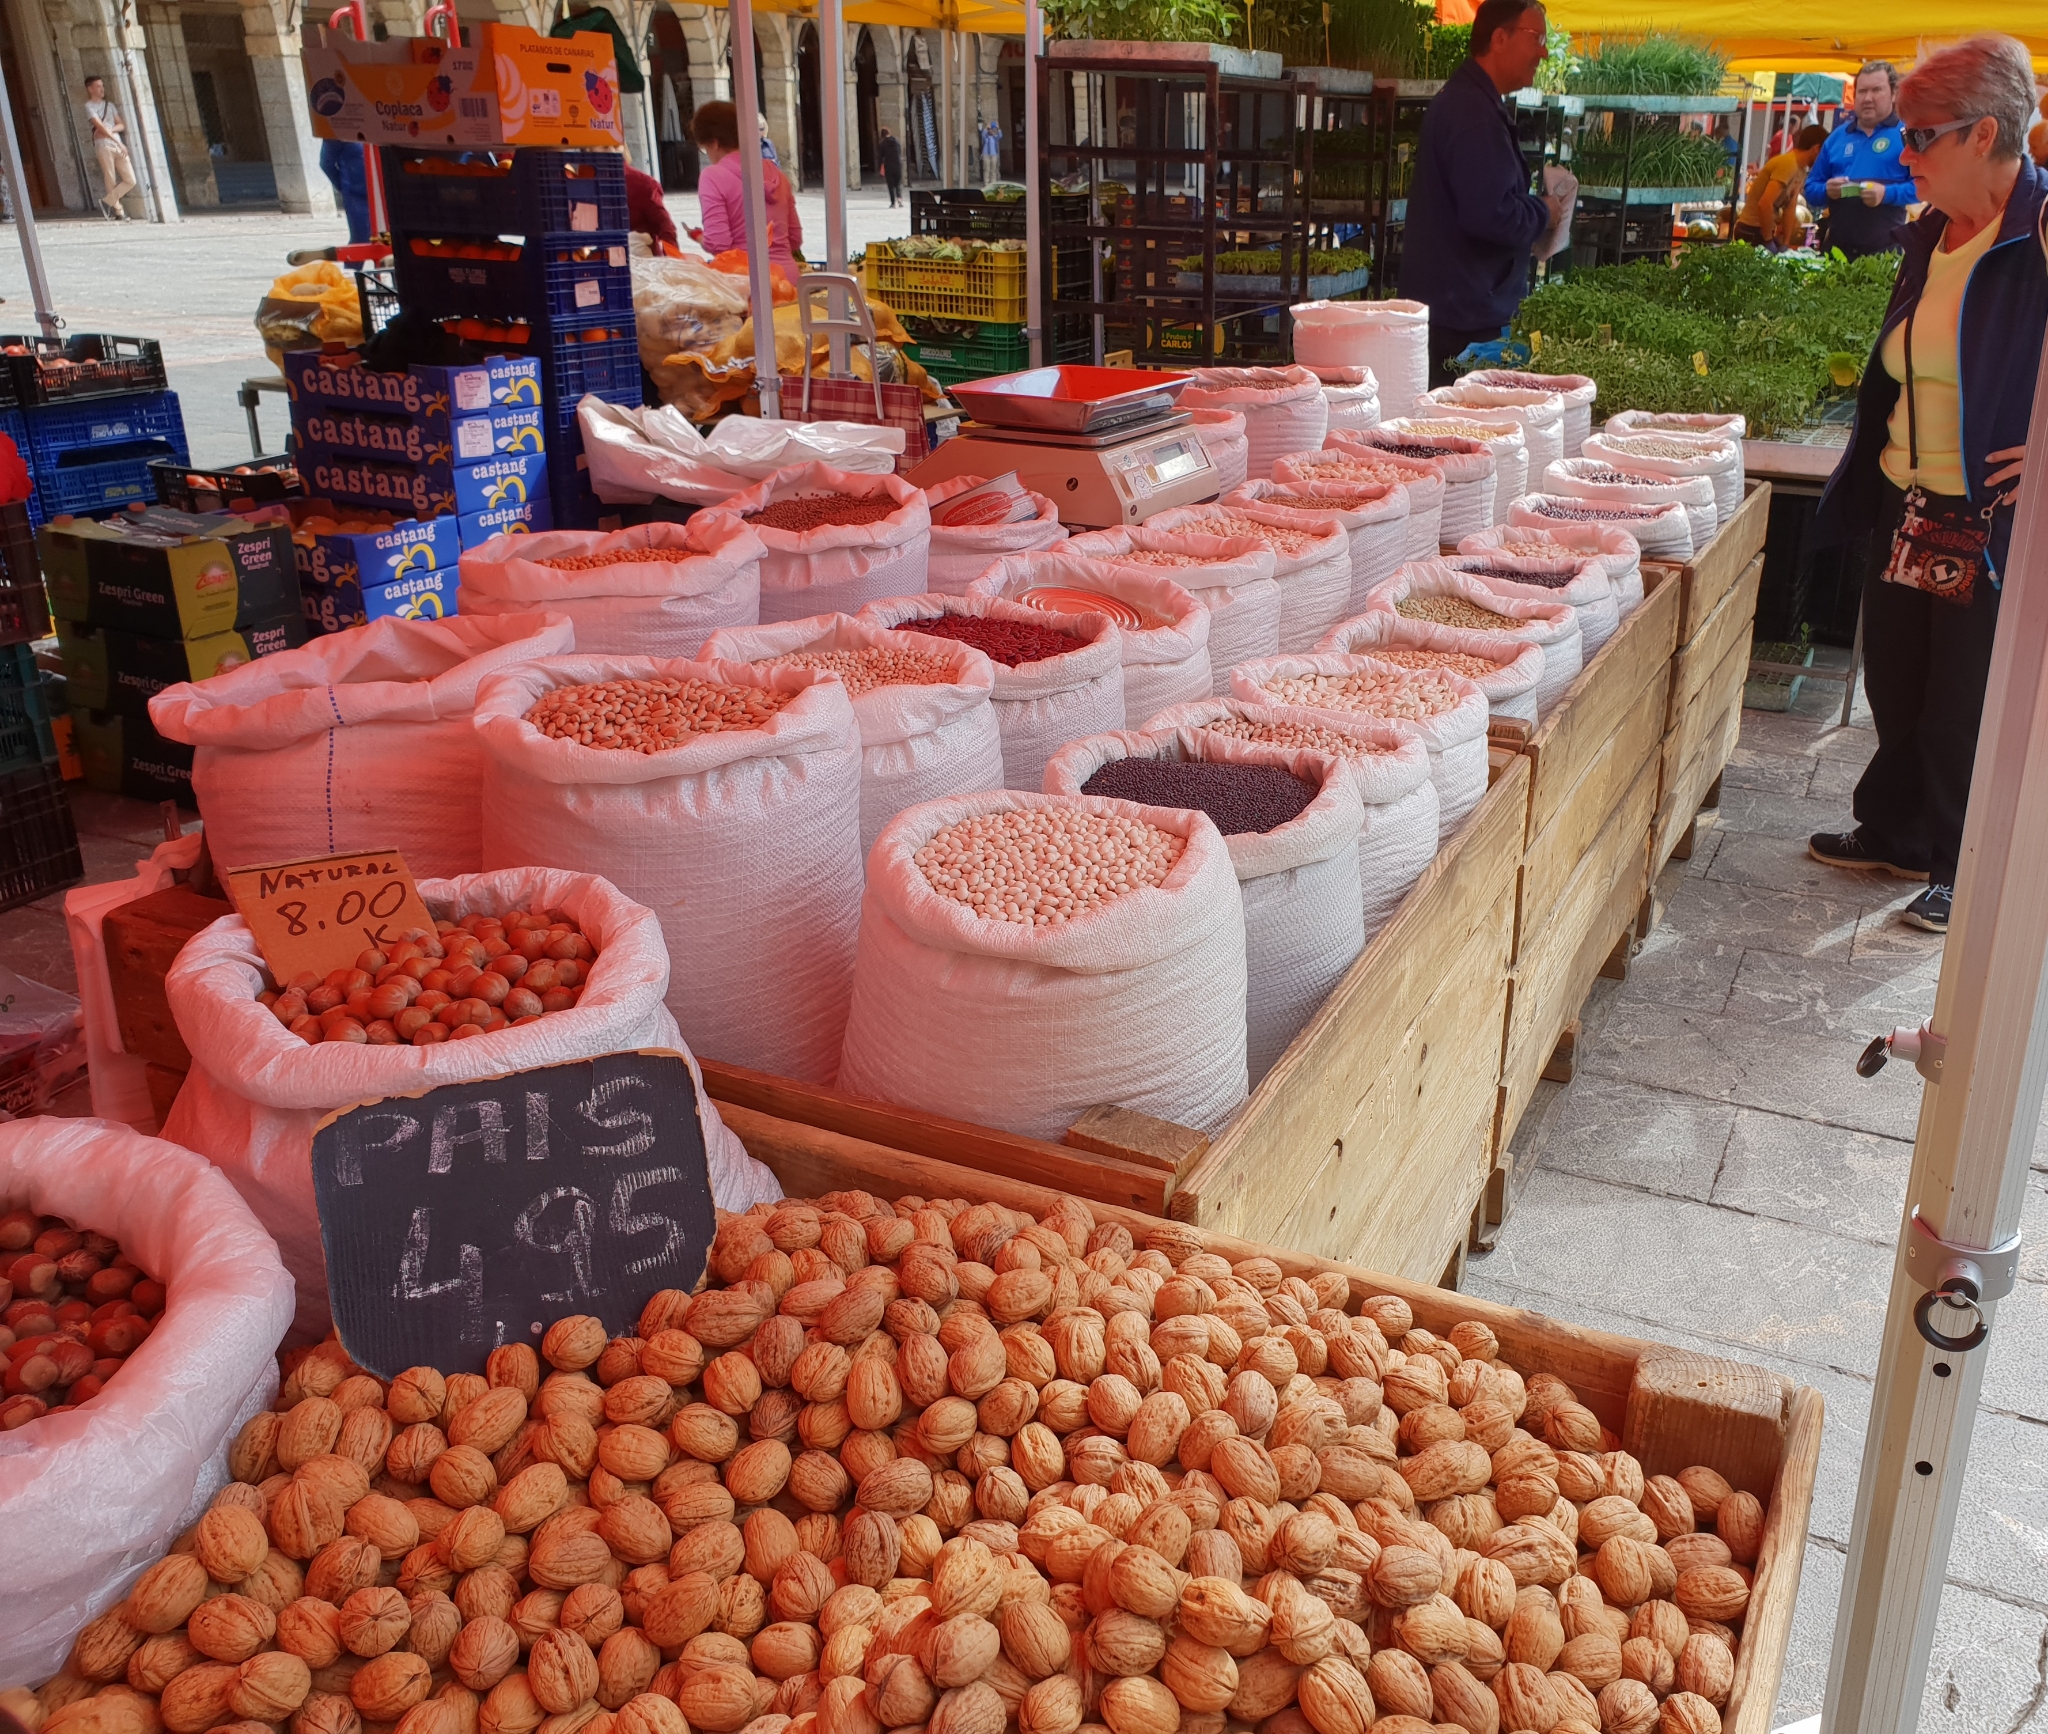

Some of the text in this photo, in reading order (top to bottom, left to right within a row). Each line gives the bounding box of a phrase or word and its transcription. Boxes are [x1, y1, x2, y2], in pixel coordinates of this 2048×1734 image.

[554, 46, 563, 56] DE
[589, 117, 614, 130] Natur
[1160, 340, 1193, 350] CARLOS
[491, 362, 536, 380] castang
[302, 365, 421, 413] castang
[494, 411, 539, 430] castang
[307, 417, 423, 462] castang
[472, 457, 527, 480] castang
[315, 465, 429, 510] castang
[479, 504, 533, 528] castang
[237, 537, 271, 555] Zespri
[376, 523, 436, 550] castang
[240, 550, 273, 566] Green
[98, 581, 132, 600] Zespri
[133, 588, 165, 605] Green
[384, 572, 444, 601] castang
[252, 624, 285, 644] Zespri
[256, 638, 287, 655] Green
[117, 671, 150, 689] Zespri
[132, 757, 165, 775] Zespri
[166, 764, 192, 780] Gree
[260, 862, 398, 900] NATURAL
